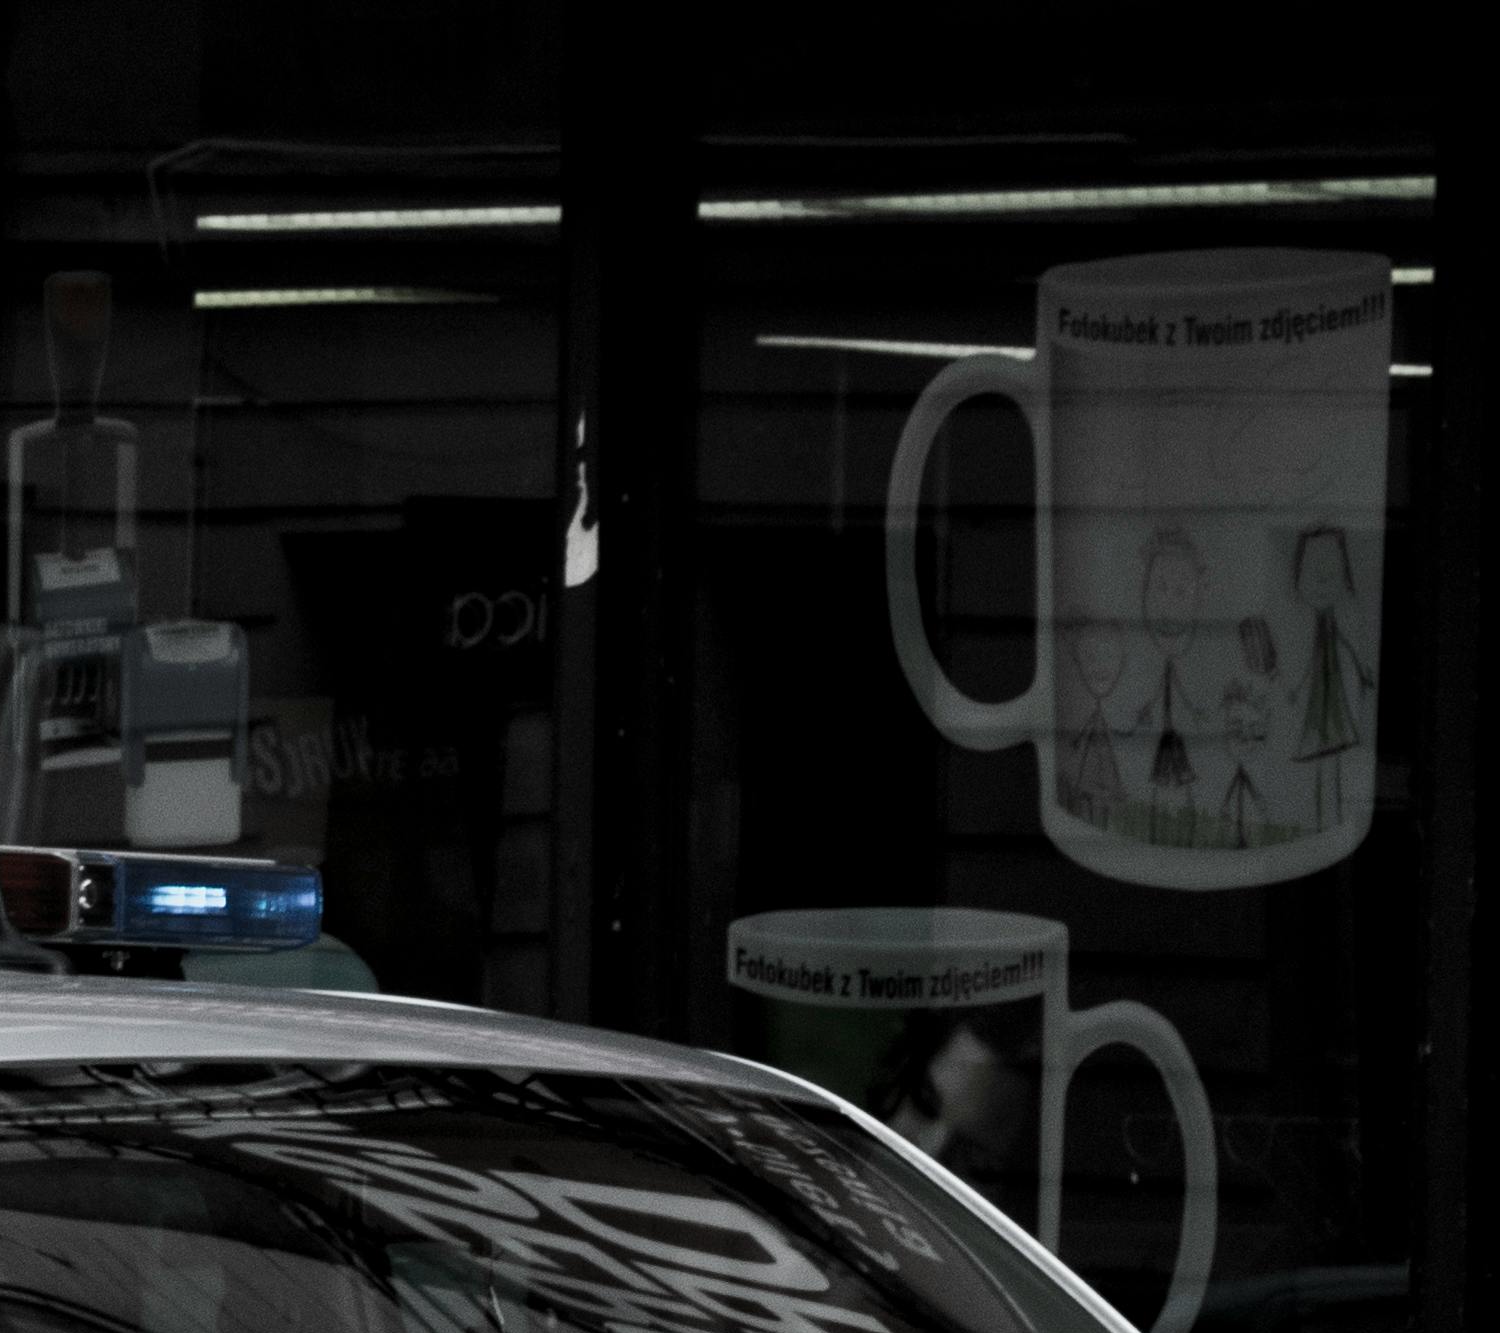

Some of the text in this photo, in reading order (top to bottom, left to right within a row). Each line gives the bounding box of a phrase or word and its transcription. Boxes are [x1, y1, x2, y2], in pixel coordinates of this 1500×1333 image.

[1058, 307, 1159, 345] Fotokubek
[1165, 322, 1176, 346] z
[1183, 315, 1253, 347] Twoim
[735, 947, 1045, 1002] Fotokubek z Twoim zdjęciem!!!
